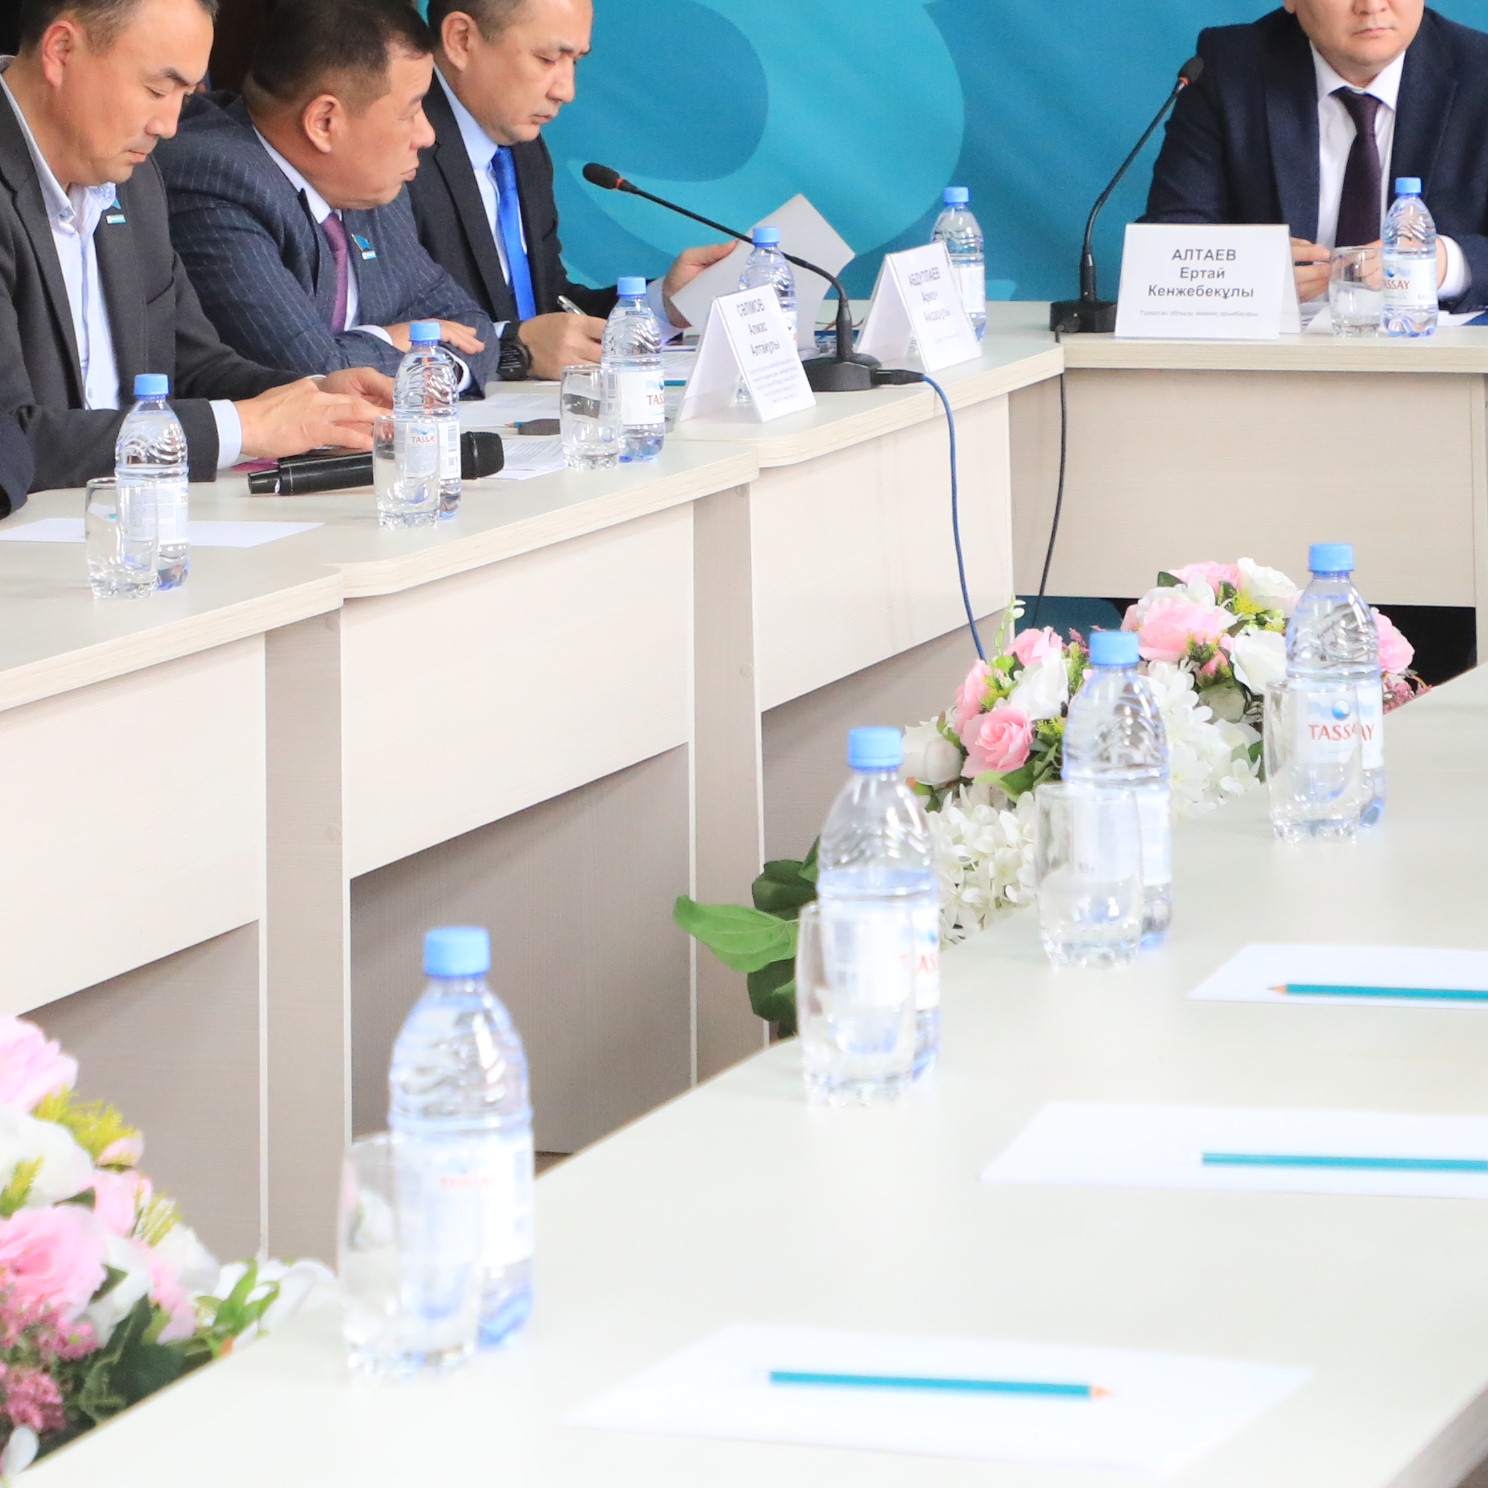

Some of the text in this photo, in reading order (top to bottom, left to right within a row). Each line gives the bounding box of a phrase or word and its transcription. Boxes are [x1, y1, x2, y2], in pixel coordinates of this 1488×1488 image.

[1171, 248, 1237, 261] АЛТАЕВ
[1179, 266, 1226, 282] Ертай
[1382, 279, 1410, 290] SSAY
[1147, 284, 1254, 300] Кенжебекұлы
